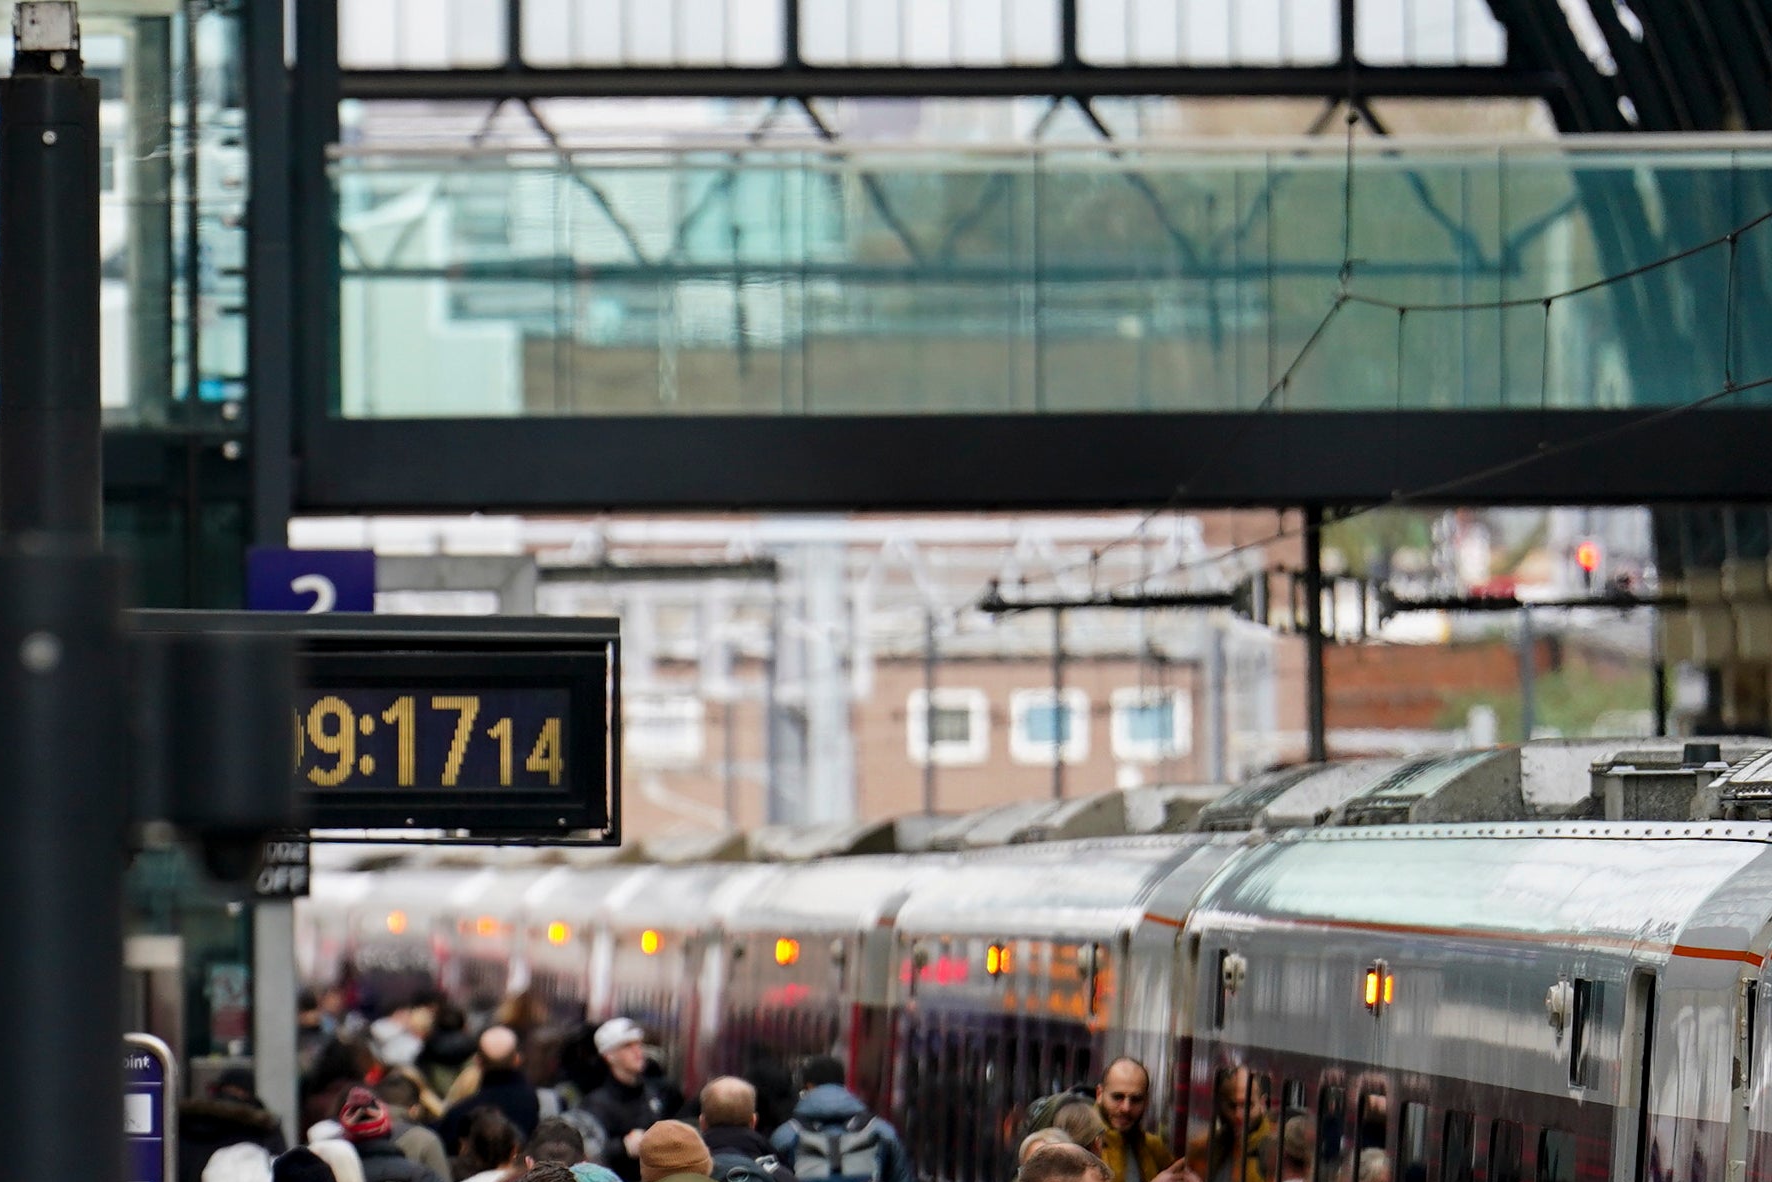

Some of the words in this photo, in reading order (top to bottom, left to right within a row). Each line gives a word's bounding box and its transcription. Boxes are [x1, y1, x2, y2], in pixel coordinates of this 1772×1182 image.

[294, 697, 478, 785] 9:17
[487, 719, 563, 785] 14
[256, 866, 306, 896] OFF
